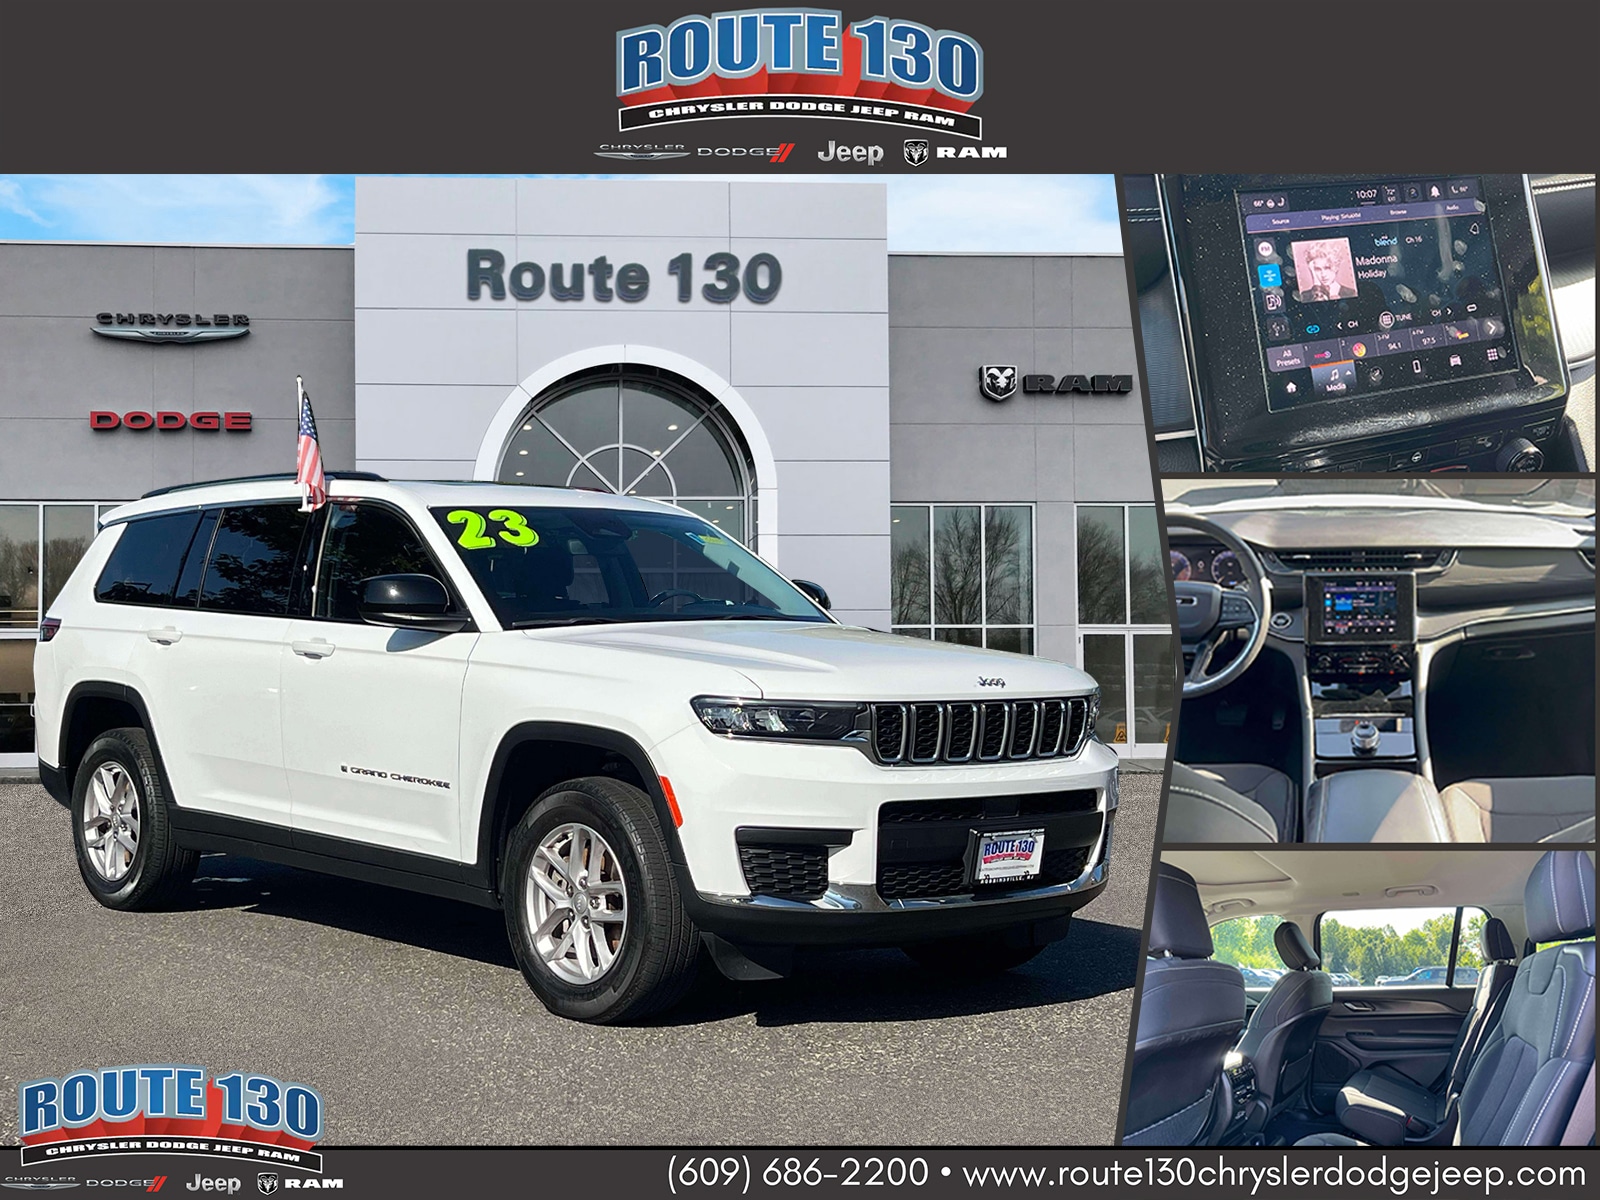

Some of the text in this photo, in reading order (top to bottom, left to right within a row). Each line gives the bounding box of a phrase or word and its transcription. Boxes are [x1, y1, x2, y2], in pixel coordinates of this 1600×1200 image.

[1355, 189, 1378, 199] 10:07
[1374, 237, 1398, 247] blend
[1355, 255, 1399, 267] Madonna
[467, 248, 782, 304] Route 130
[1357, 269, 1387, 279] Holiday
[96, 312, 250, 326] CHRYSLER
[1395, 312, 1413, 321] TUNE
[1276, 358, 1301, 367] Presets
[1023, 374, 1133, 394] RAM
[1326, 382, 1347, 392] Media
[90, 410, 252, 432] DODGE
[446, 508, 540, 550] 23
[977, 675, 1006, 689] Jeep
[350, 766, 451, 789] GRAND CHEROKEE
[983, 839, 1036, 856] ROUTE 130
